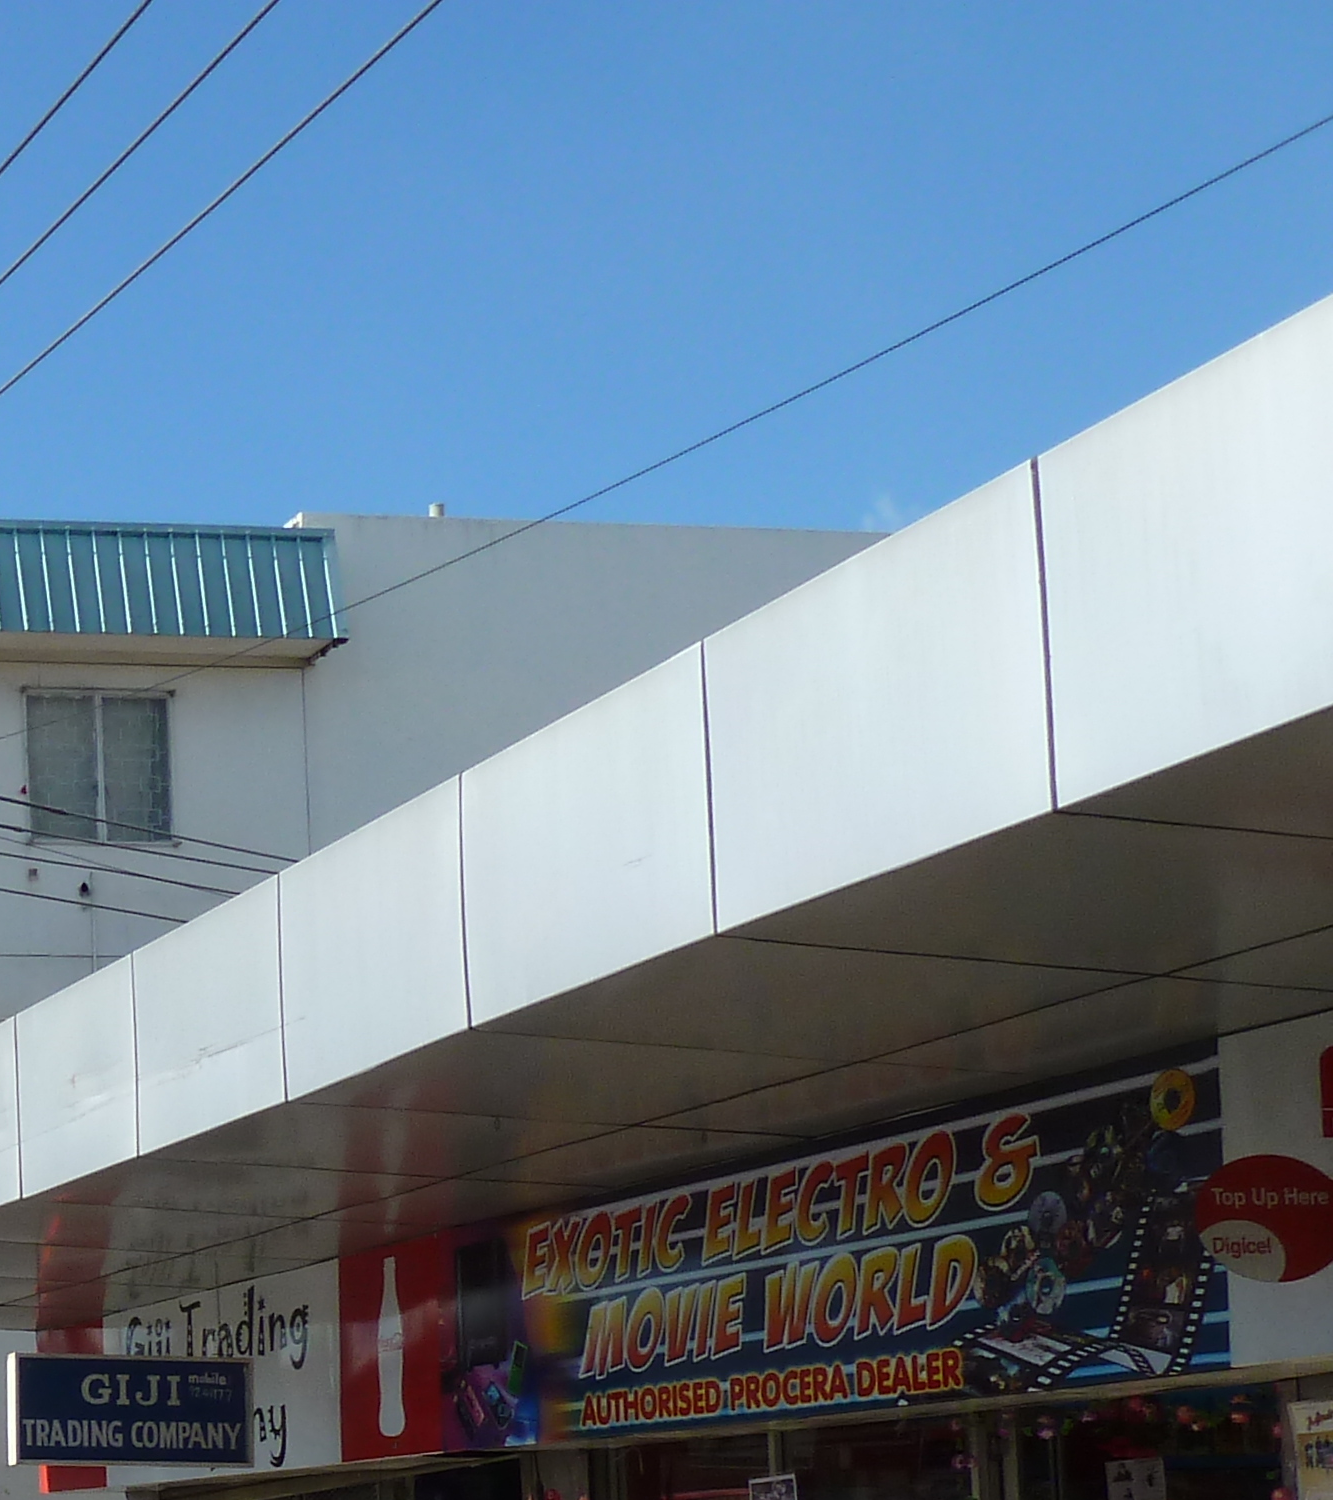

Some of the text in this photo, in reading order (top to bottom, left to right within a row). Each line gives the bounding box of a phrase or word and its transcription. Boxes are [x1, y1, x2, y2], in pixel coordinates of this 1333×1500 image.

[520, 1112, 1039, 1300] EXOTIC ELECTRO &
[1210, 1187, 1330, 1209] Top Up Here
[1212, 1237, 1272, 1258] Digicel
[179, 1285, 309, 1369] Trading
[579, 1233, 981, 1381] MOVIE WORLD
[81, 1373, 182, 1407] GIJI
[579, 1349, 963, 1429] AUTHORISED PROCERA DEALER
[21, 1418, 243, 1451] TRADING COMPANY
